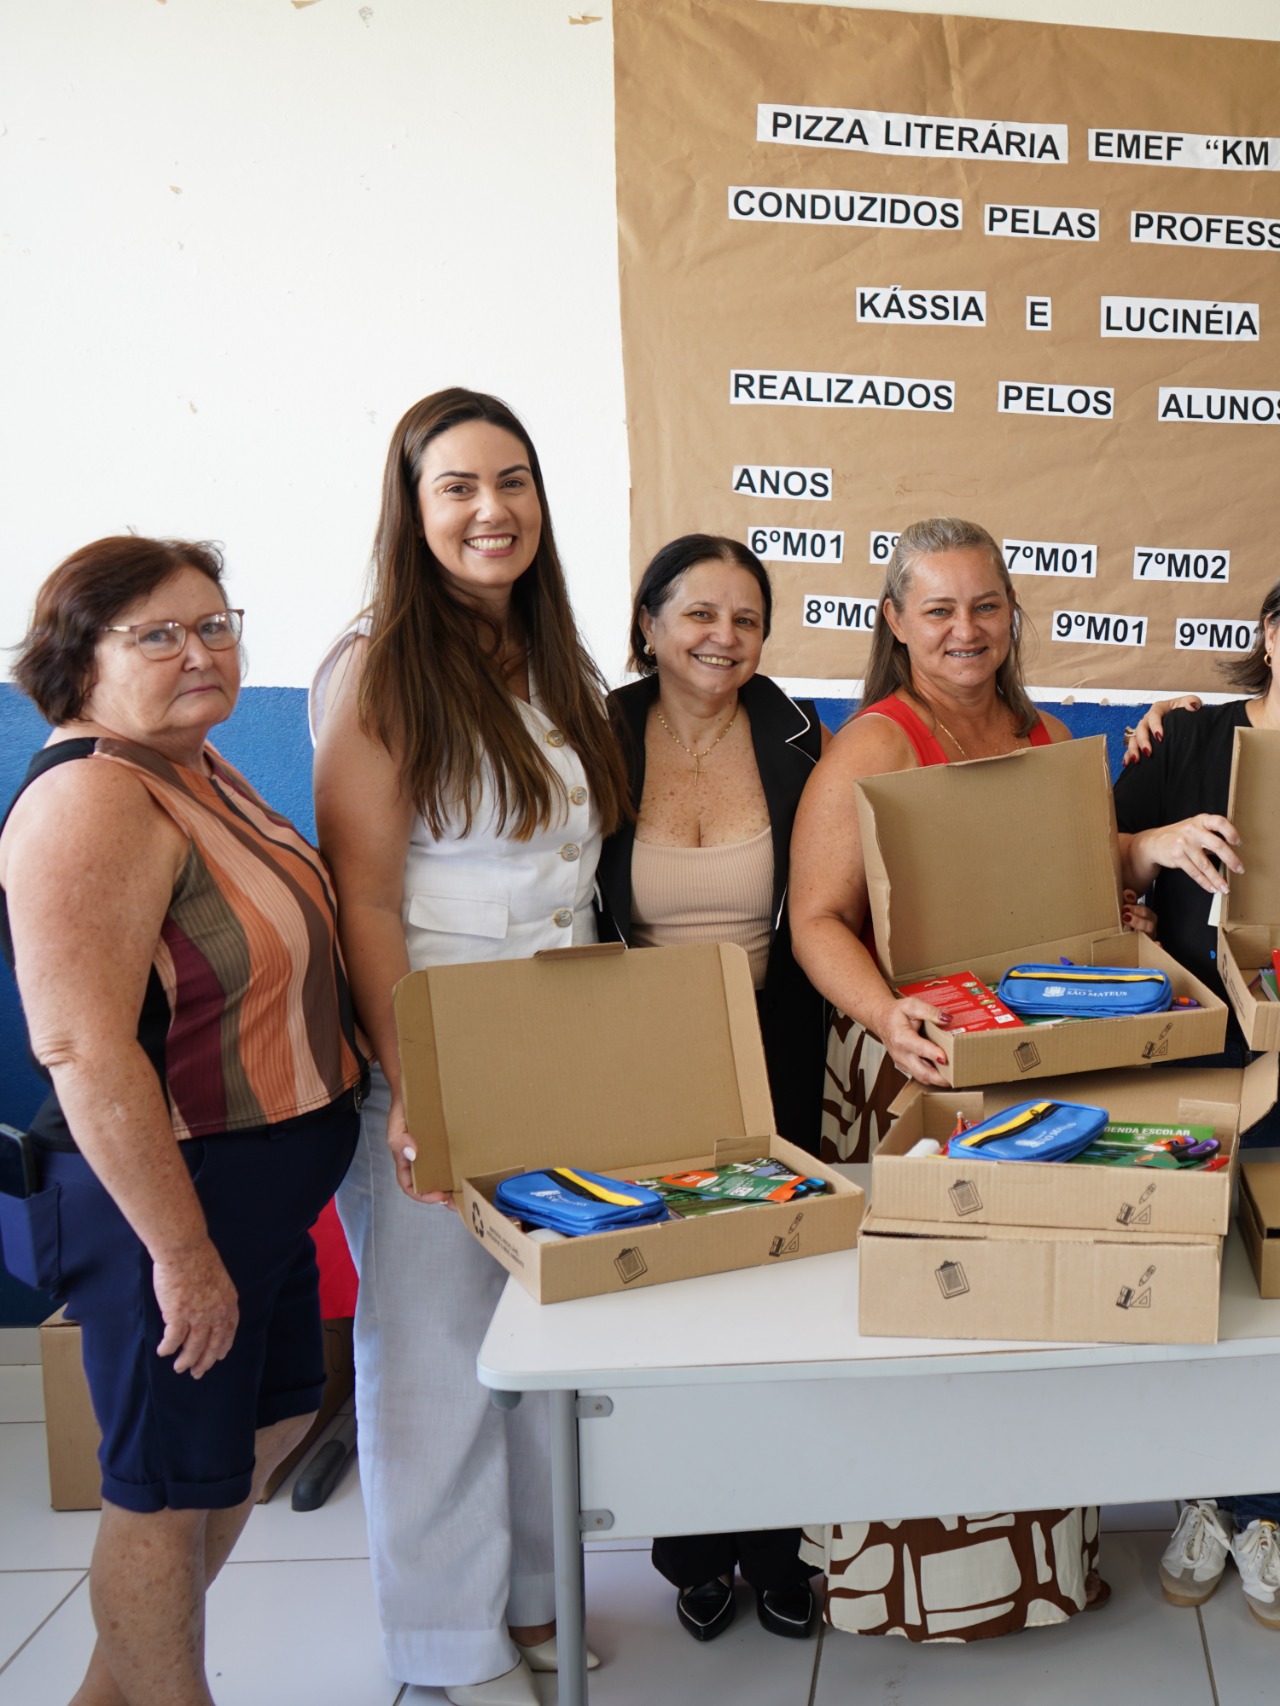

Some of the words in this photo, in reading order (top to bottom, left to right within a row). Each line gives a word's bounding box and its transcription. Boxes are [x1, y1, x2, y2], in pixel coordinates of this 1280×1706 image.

[772, 112, 869, 146] PIZZA
[884, 121, 1060, 160] LITERÁRIA
[1095, 132, 1184, 161] EMEF
[733, 190, 959, 229] CONDUZIDOS
[988, 207, 1096, 239] PELAS
[860, 287, 984, 322] KÁSSIA
[1030, 301, 1048, 327] E
[1106, 303, 1258, 335] LUCINÉIA
[734, 373, 952, 410] REALIZADOS
[1004, 385, 1112, 416] PELOS
[734, 468, 829, 498] ANOS
[805, 600, 877, 629] 8ºM0
[1179, 622, 1252, 650] 9ºM0
[1103, 1126, 1139, 1134] GENDA
[1142, 1128, 1191, 1137] ESCOLAR
